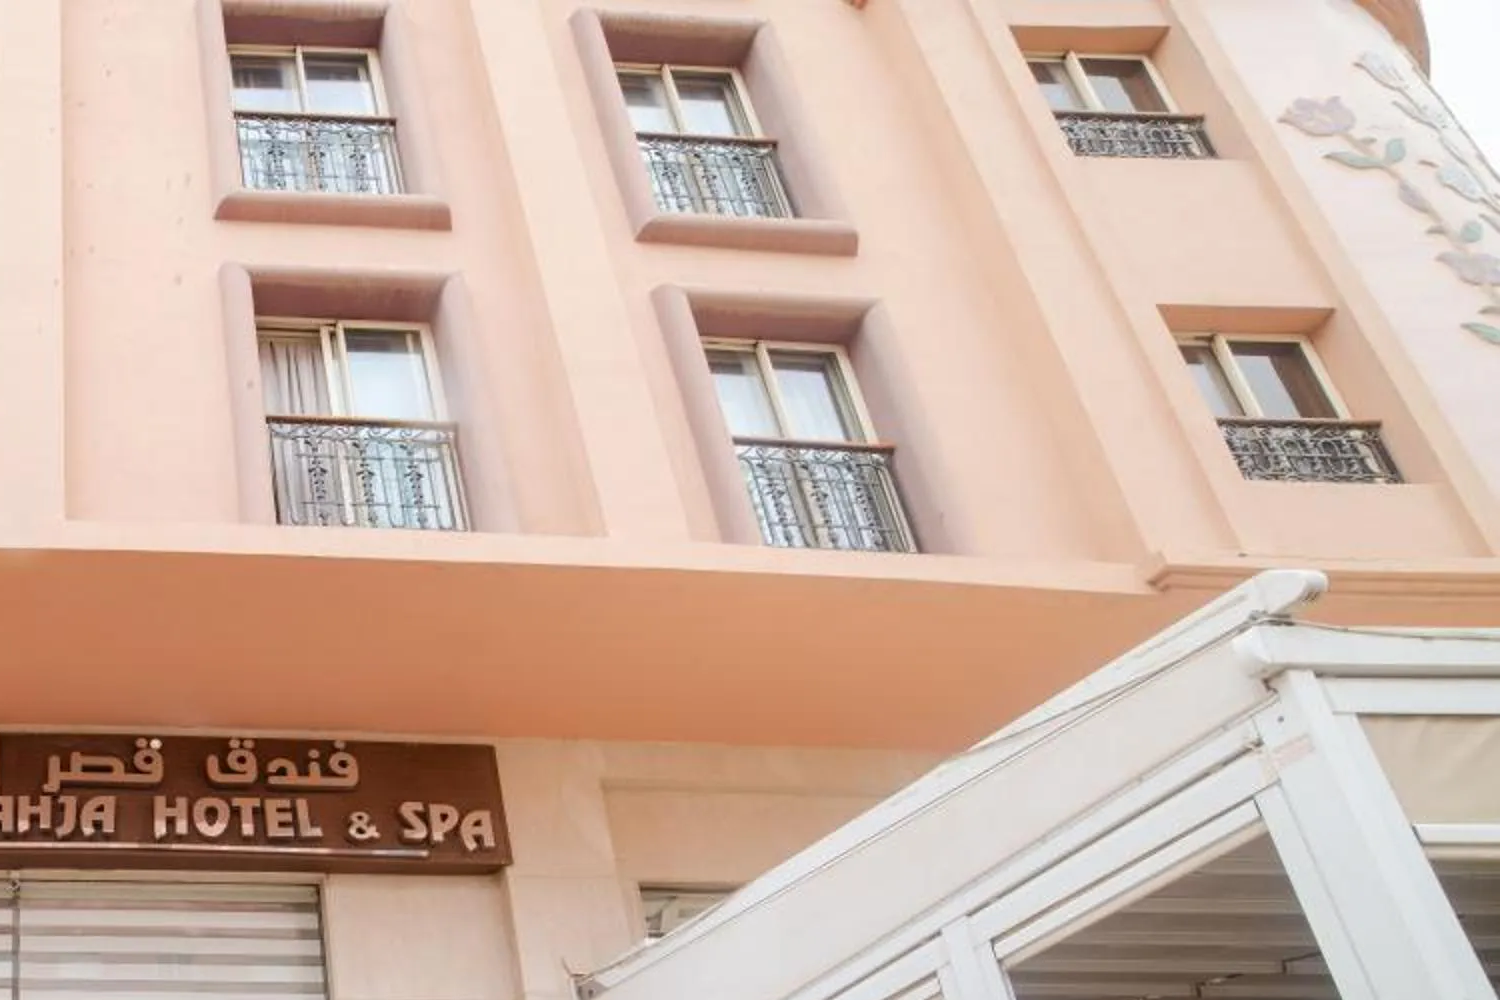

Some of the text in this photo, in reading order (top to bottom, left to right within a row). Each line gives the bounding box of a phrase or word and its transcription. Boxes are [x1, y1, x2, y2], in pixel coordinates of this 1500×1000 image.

[43, 738, 165, 793] قصر
[207, 738, 360, 789] فندق
[153, 795, 324, 840] HOTEL
[348, 811, 381, 840] &
[401, 801, 497, 853] SPA
